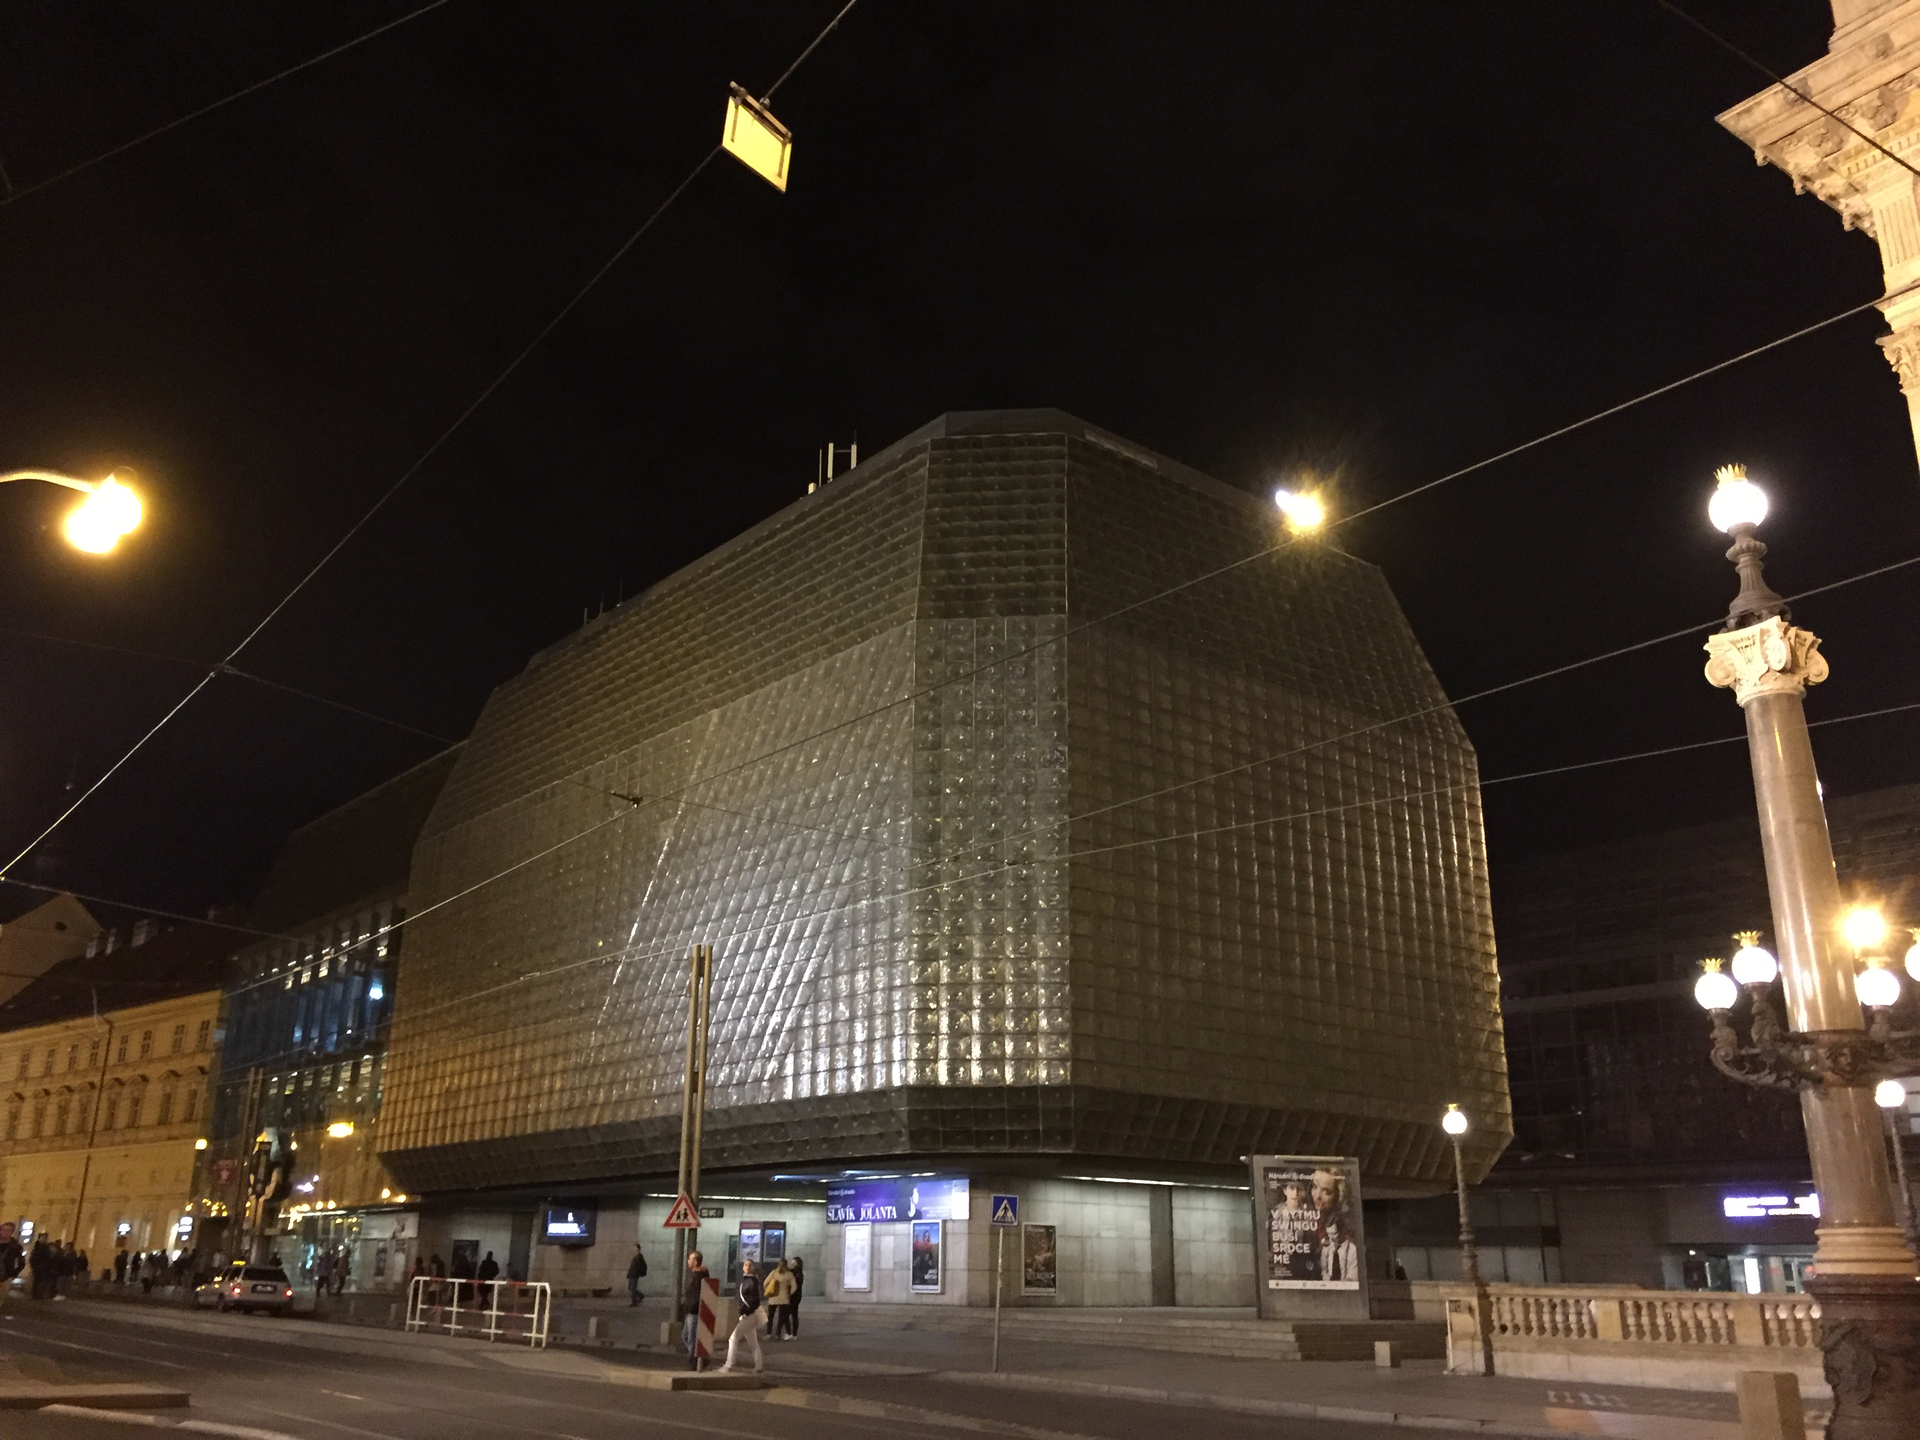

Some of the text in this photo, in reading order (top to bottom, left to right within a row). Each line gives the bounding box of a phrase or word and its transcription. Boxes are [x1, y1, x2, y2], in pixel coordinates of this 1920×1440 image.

[827, 1204, 897, 1221] SLAVÍK JOLANTA
[1270, 1209, 1321, 1220] V RYTMU
[1271, 1220, 1318, 1231] SWINGU
[1272, 1243, 1311, 1254] SRDCE
